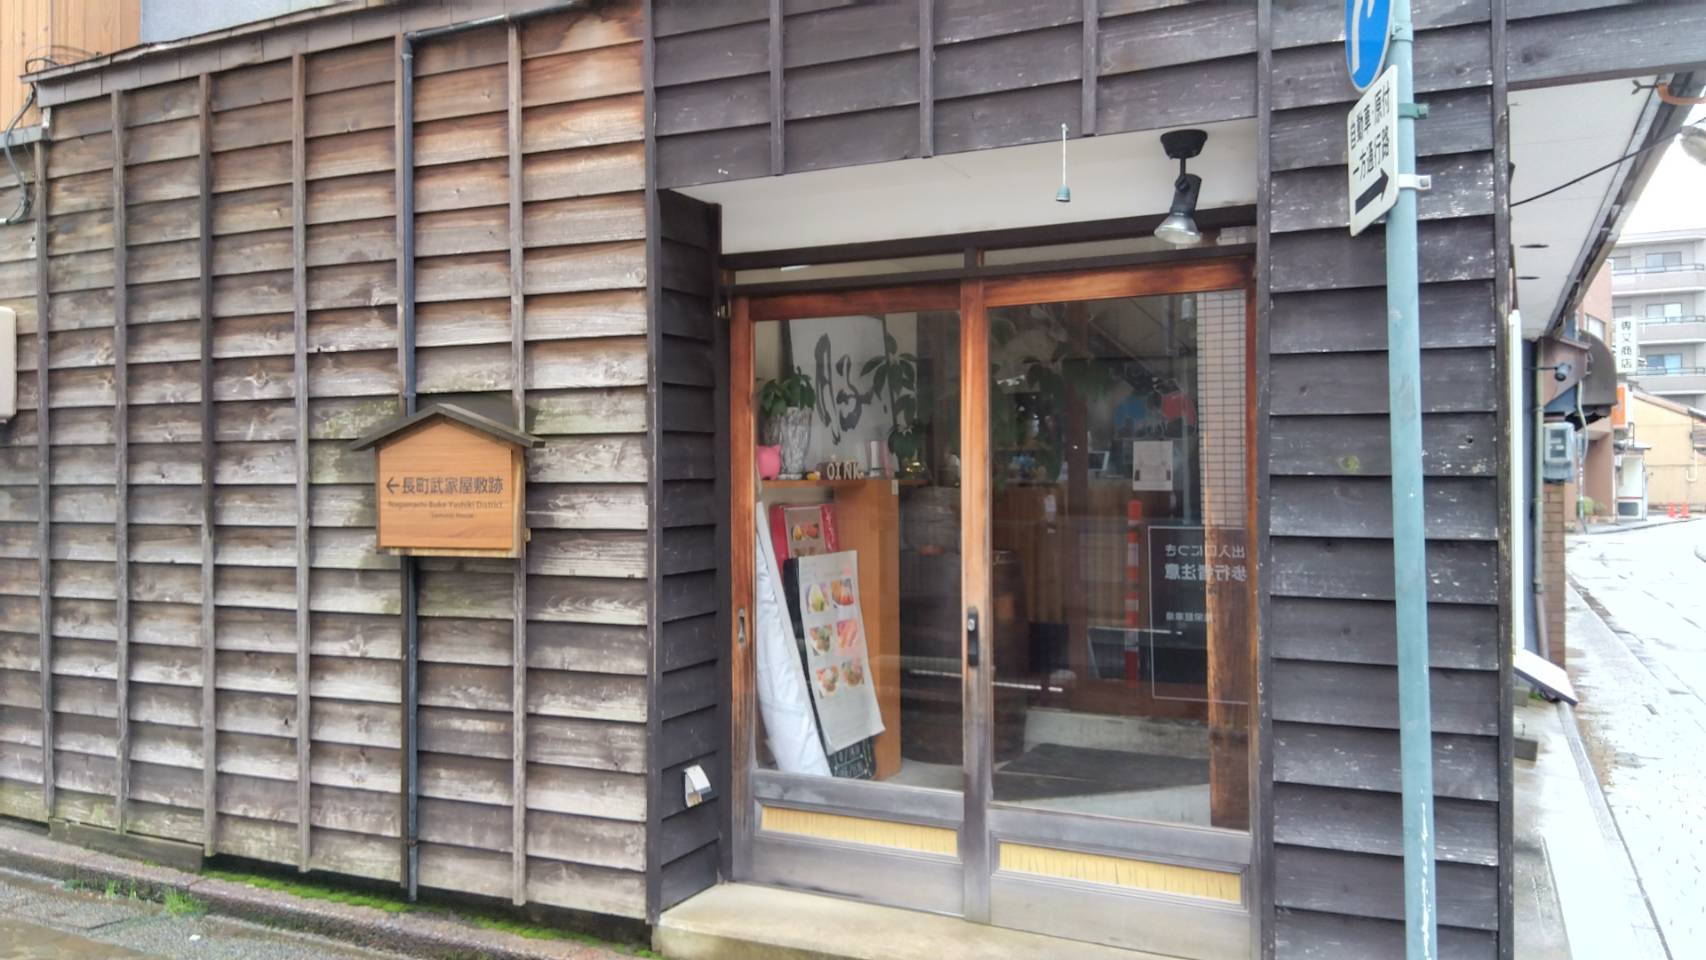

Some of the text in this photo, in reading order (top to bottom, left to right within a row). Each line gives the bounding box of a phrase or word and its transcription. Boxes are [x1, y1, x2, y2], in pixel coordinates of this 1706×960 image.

[402, 477, 503, 495] 長町武家屋敷跡
[476, 501, 503, 509] District
